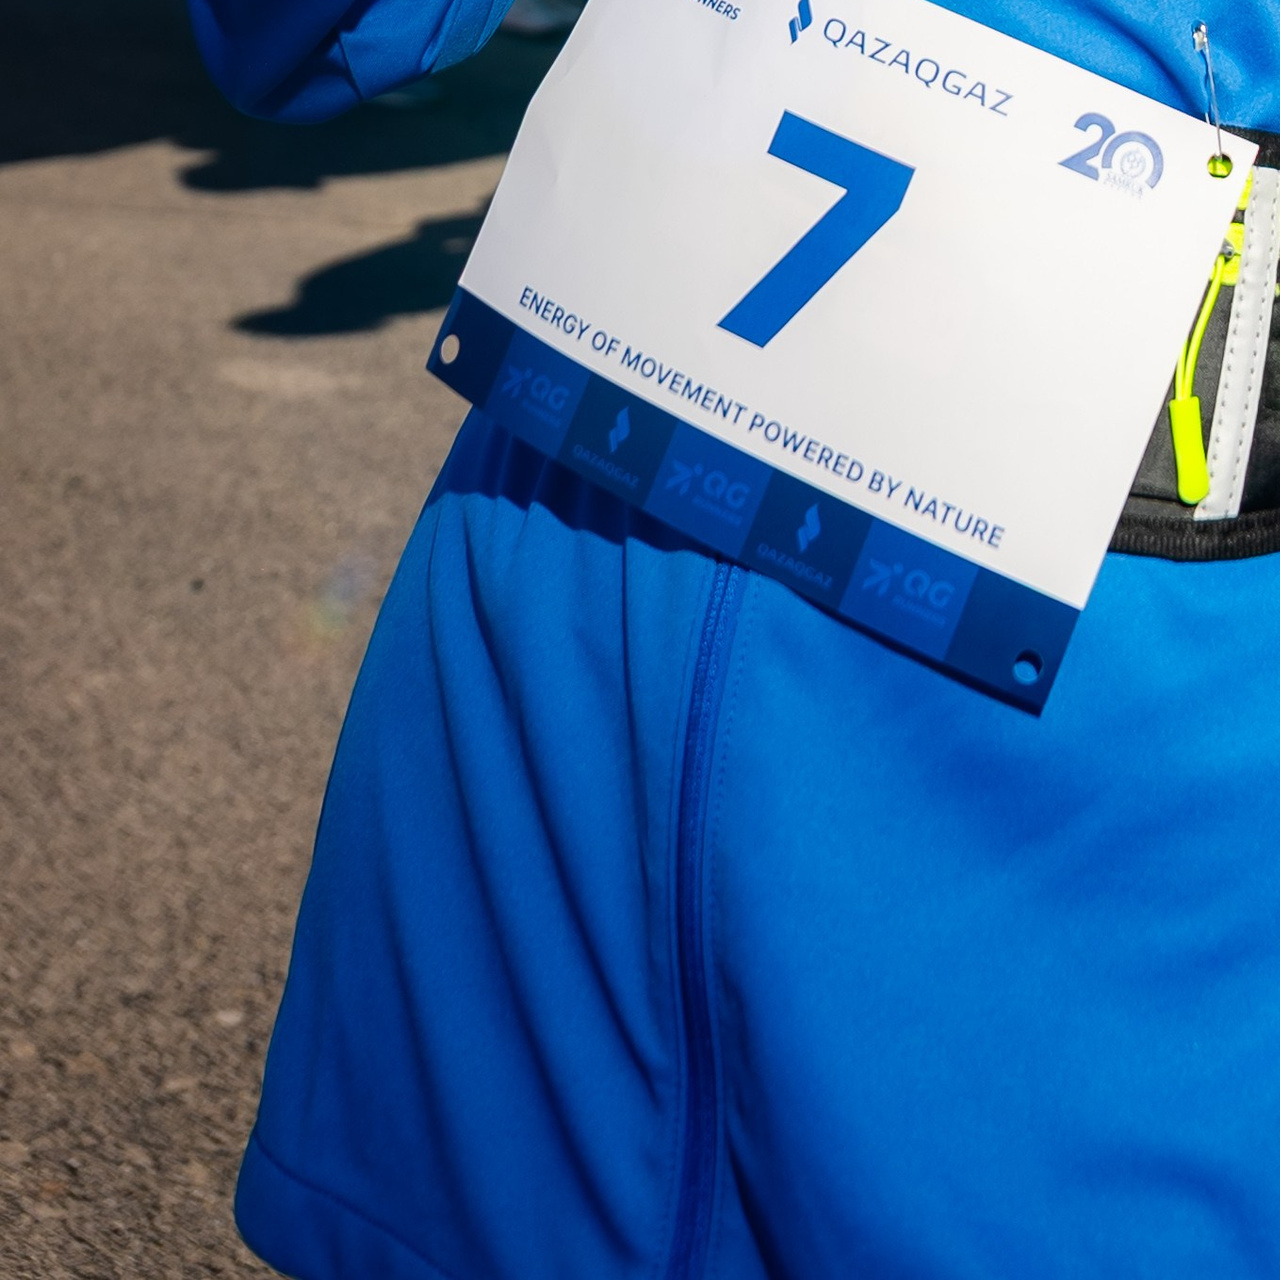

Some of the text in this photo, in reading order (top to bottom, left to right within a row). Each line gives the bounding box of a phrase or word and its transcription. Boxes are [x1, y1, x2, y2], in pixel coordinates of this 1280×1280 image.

[823, 17, 1015, 117] QAZAQGAZ
[1058, 112, 1164, 190] 20
[716, 109, 916, 349] 7
[519, 285, 591, 341] ENERGY
[591, 330, 622, 357] OF
[620, 345, 748, 425] MOVEMENT
[748, 412, 864, 483] POWERED
[868, 469, 903, 499] BY
[904, 487, 1005, 549] NATURE
